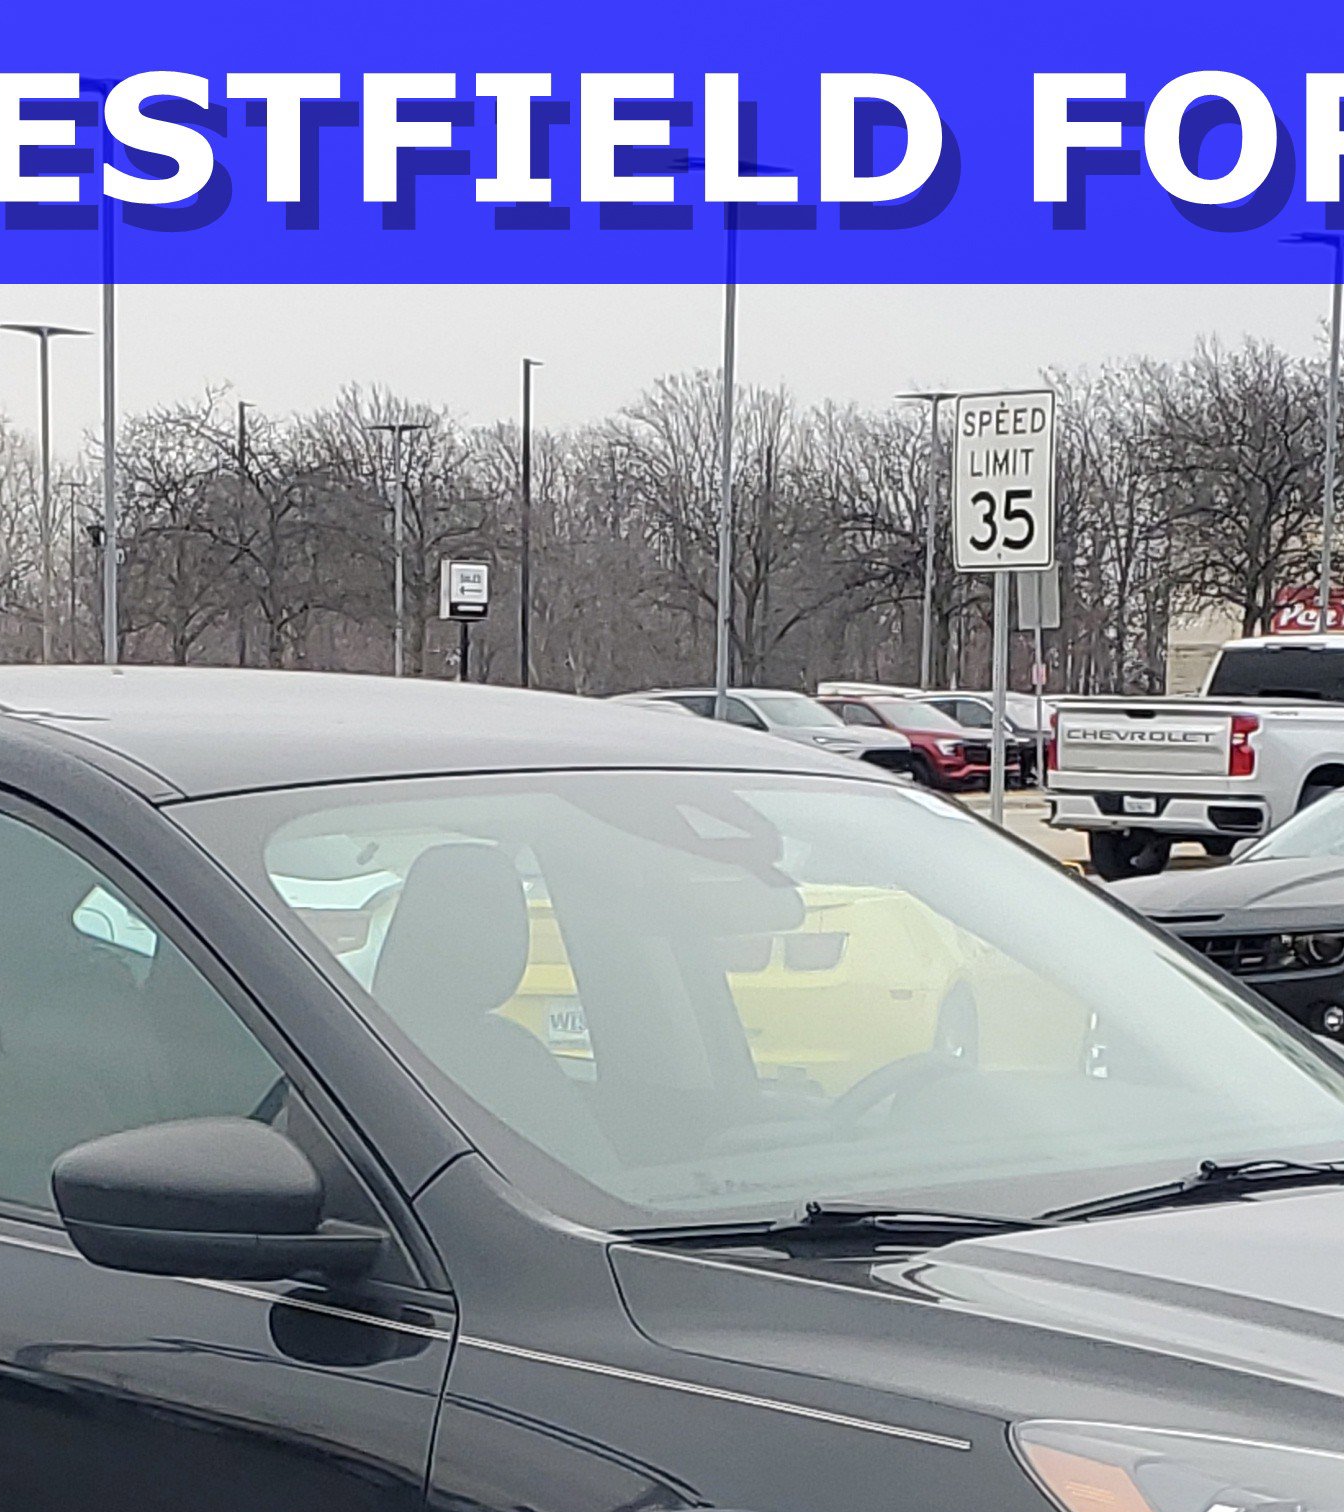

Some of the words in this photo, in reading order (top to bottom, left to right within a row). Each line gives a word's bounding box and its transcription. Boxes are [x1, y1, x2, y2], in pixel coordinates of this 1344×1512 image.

[962, 407, 1046, 437] SPEED
[970, 448, 1035, 478] LIMIT
[969, 488, 1035, 551] 35
[1066, 728, 1215, 743] CHEVROLET
